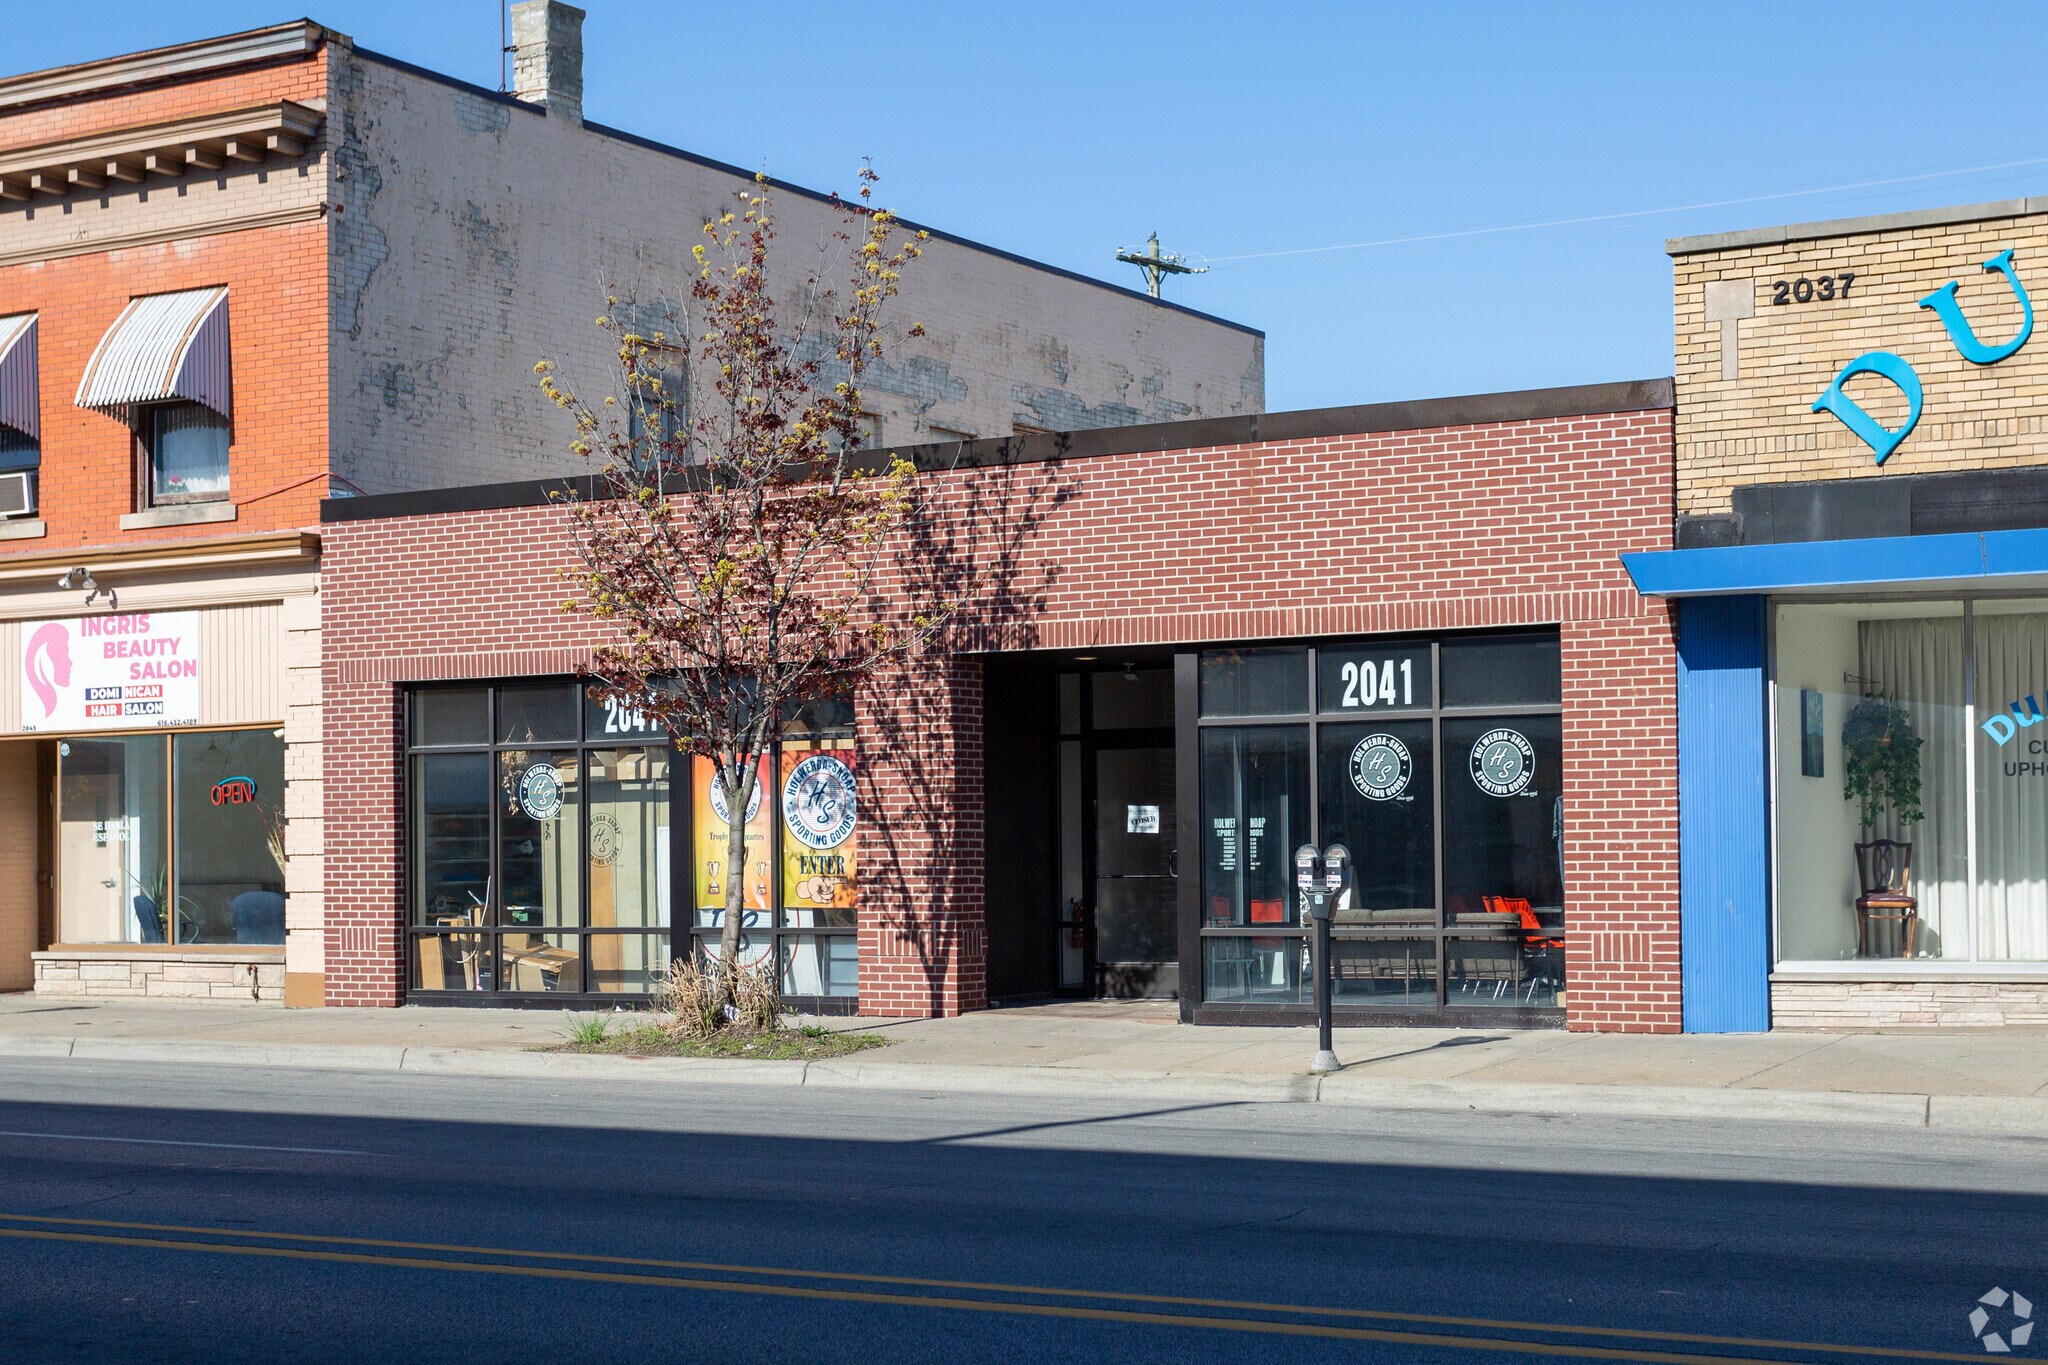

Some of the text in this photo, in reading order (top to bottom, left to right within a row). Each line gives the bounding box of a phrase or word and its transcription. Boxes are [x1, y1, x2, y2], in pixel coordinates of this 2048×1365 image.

[1772, 272, 1856, 306] 2037
[81, 613, 150, 637] INGRIS
[103, 637, 181, 659] BEAUTY
[129, 659, 197, 680] SALON
[90, 685, 160, 700] DOMI NICAN
[1341, 658, 1412, 707] 2041
[90, 701, 163, 717] HAIR SALON
[1353, 736, 1409, 763] HOLWERDA-SNOAP
[1473, 731, 1531, 759] HOLWERDA-SNOAP
[787, 759, 856, 796] HOLWERDA-SNOAP
[2004, 762, 2048, 776] UPH
[211, 782, 252, 806] OPEN
[1354, 774, 1407, 798] SPORTING GOODS
[1475, 770, 1530, 794] SPORTING GOODS
[93, 821, 104, 831] SE
[789, 814, 855, 846] SPORTING GOODS
[1131, 815, 1156, 825] CLOSED
[800, 855, 845, 875] ENTER
